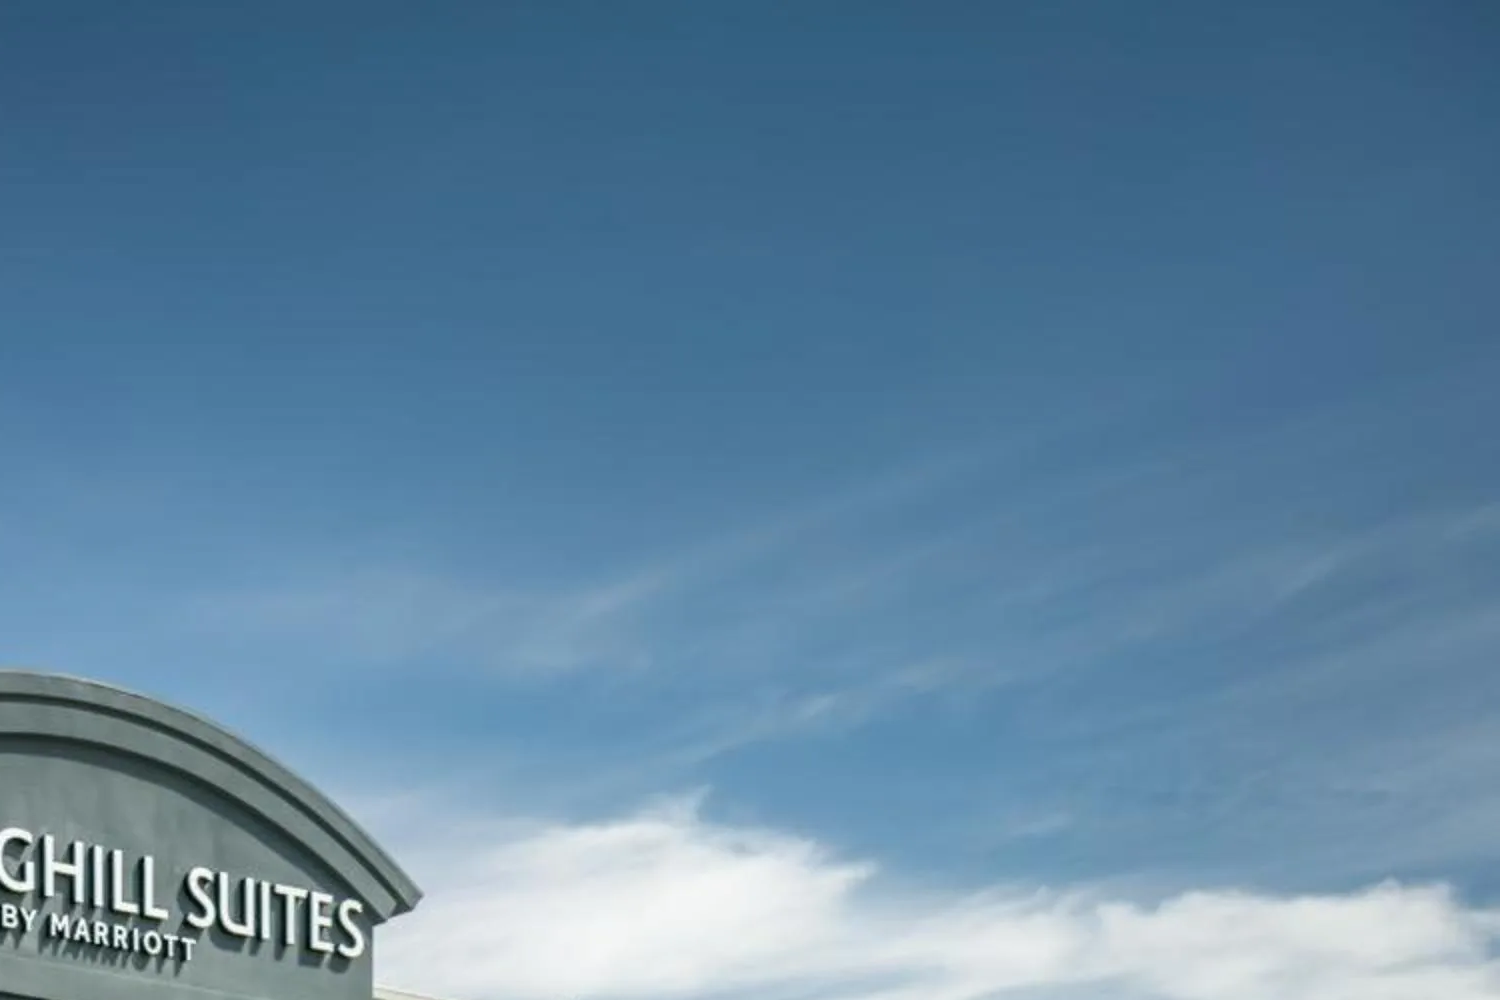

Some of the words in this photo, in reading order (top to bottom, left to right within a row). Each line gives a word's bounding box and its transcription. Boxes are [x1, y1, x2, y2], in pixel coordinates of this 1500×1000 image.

[1, 903, 37, 933] BY
[50, 914, 197, 961] MARRIOTT
[186, 866, 365, 959] SUITES
